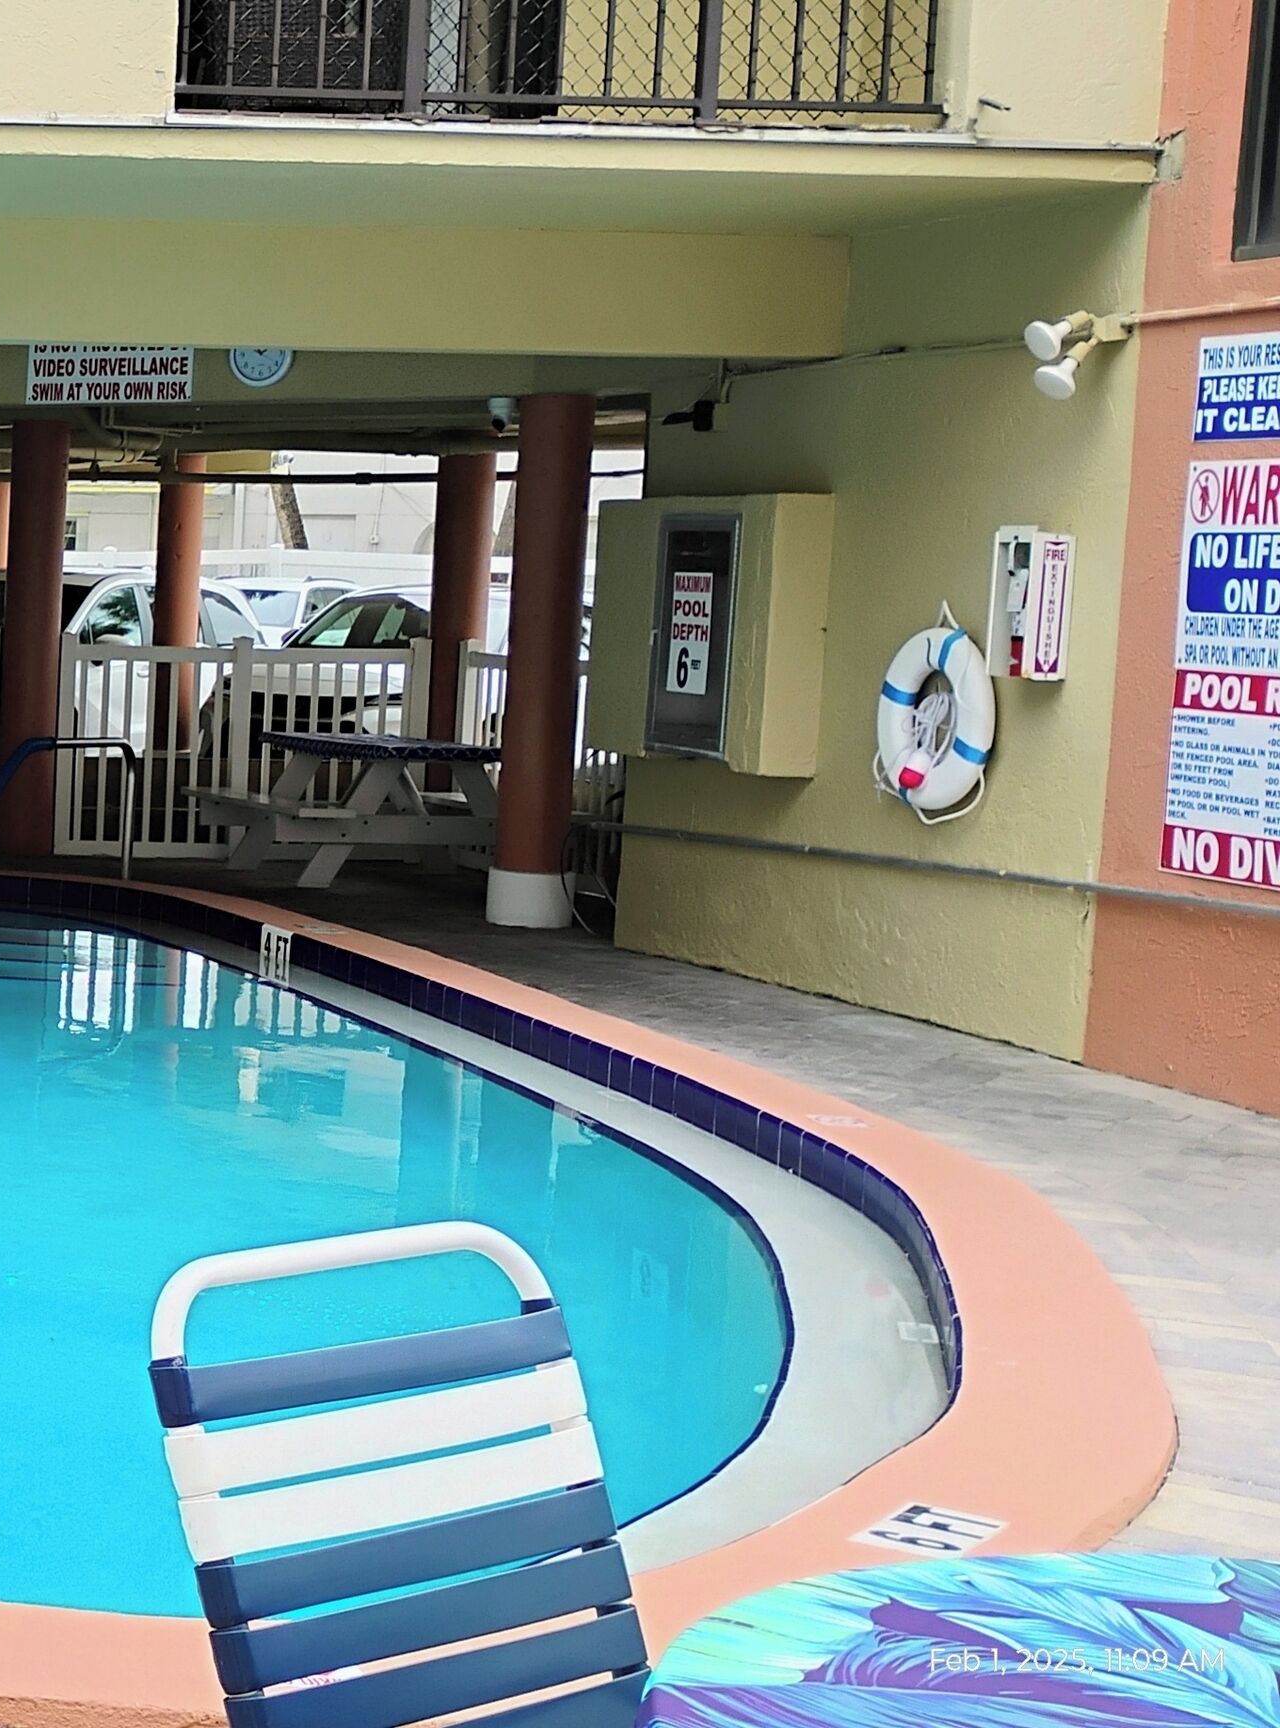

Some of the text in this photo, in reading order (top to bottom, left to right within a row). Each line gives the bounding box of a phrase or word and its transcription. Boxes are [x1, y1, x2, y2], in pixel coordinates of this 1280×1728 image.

[34, 356, 189, 377] VIDEO SURVEILLANCE
[1204, 348, 1224, 370] THIS
[1226, 346, 1235, 368] IS
[1238, 344, 1262, 368] YOUR
[32, 383, 63, 401] SWIM
[67, 382, 83, 401] AT
[86, 382, 119, 400] YOUR
[124, 382, 153, 400] OWN
[1203, 376, 1255, 403] PLEASE
[1196, 408, 1219, 433] IT
[1221, 465, 1280, 525] WAR
[1046, 549, 1065, 561] FIRE
[1195, 534, 1229, 568] NO
[675, 575, 711, 593] MAXIMUM
[1224, 578, 1259, 613] ON
[674, 600, 709, 617] POOL
[1043, 564, 1057, 666] EXTINGUISHER
[673, 623, 709, 641] DEPTH
[1185, 615, 1279, 640] CHILDREN UNDER THE AGE
[1185, 644, 1280, 669] SPA OR POOL WITHOUT AN
[676, 647, 689, 688] 6
[1183, 672, 1257, 712] POOL
[1177, 714, 1236, 727] SHOWER BEFORE
[1172, 751, 1184, 759] THE
[1186, 753, 1214, 763] FENCED
[1216, 756, 1235, 766] POOL
[1174, 740, 1266, 757] NO GLASS OR ANIMALS IN
[1170, 773, 1207, 785] UNFENCED
[1194, 765, 1211, 774] FEET
[1213, 767, 1234, 776] FROM
[1268, 778, 1280, 786] DO
[1171, 788, 1260, 806] NO FOOD OR BEVERAGES
[1177, 800, 1195, 810] POOL
[1197, 802, 1207, 811] OR
[1209, 804, 1220, 812] ON
[1221, 806, 1241, 816] POOL
[1243, 809, 1260, 819] WET
[1172, 827, 1220, 875] NO
[264, 932, 271, 953] 4
